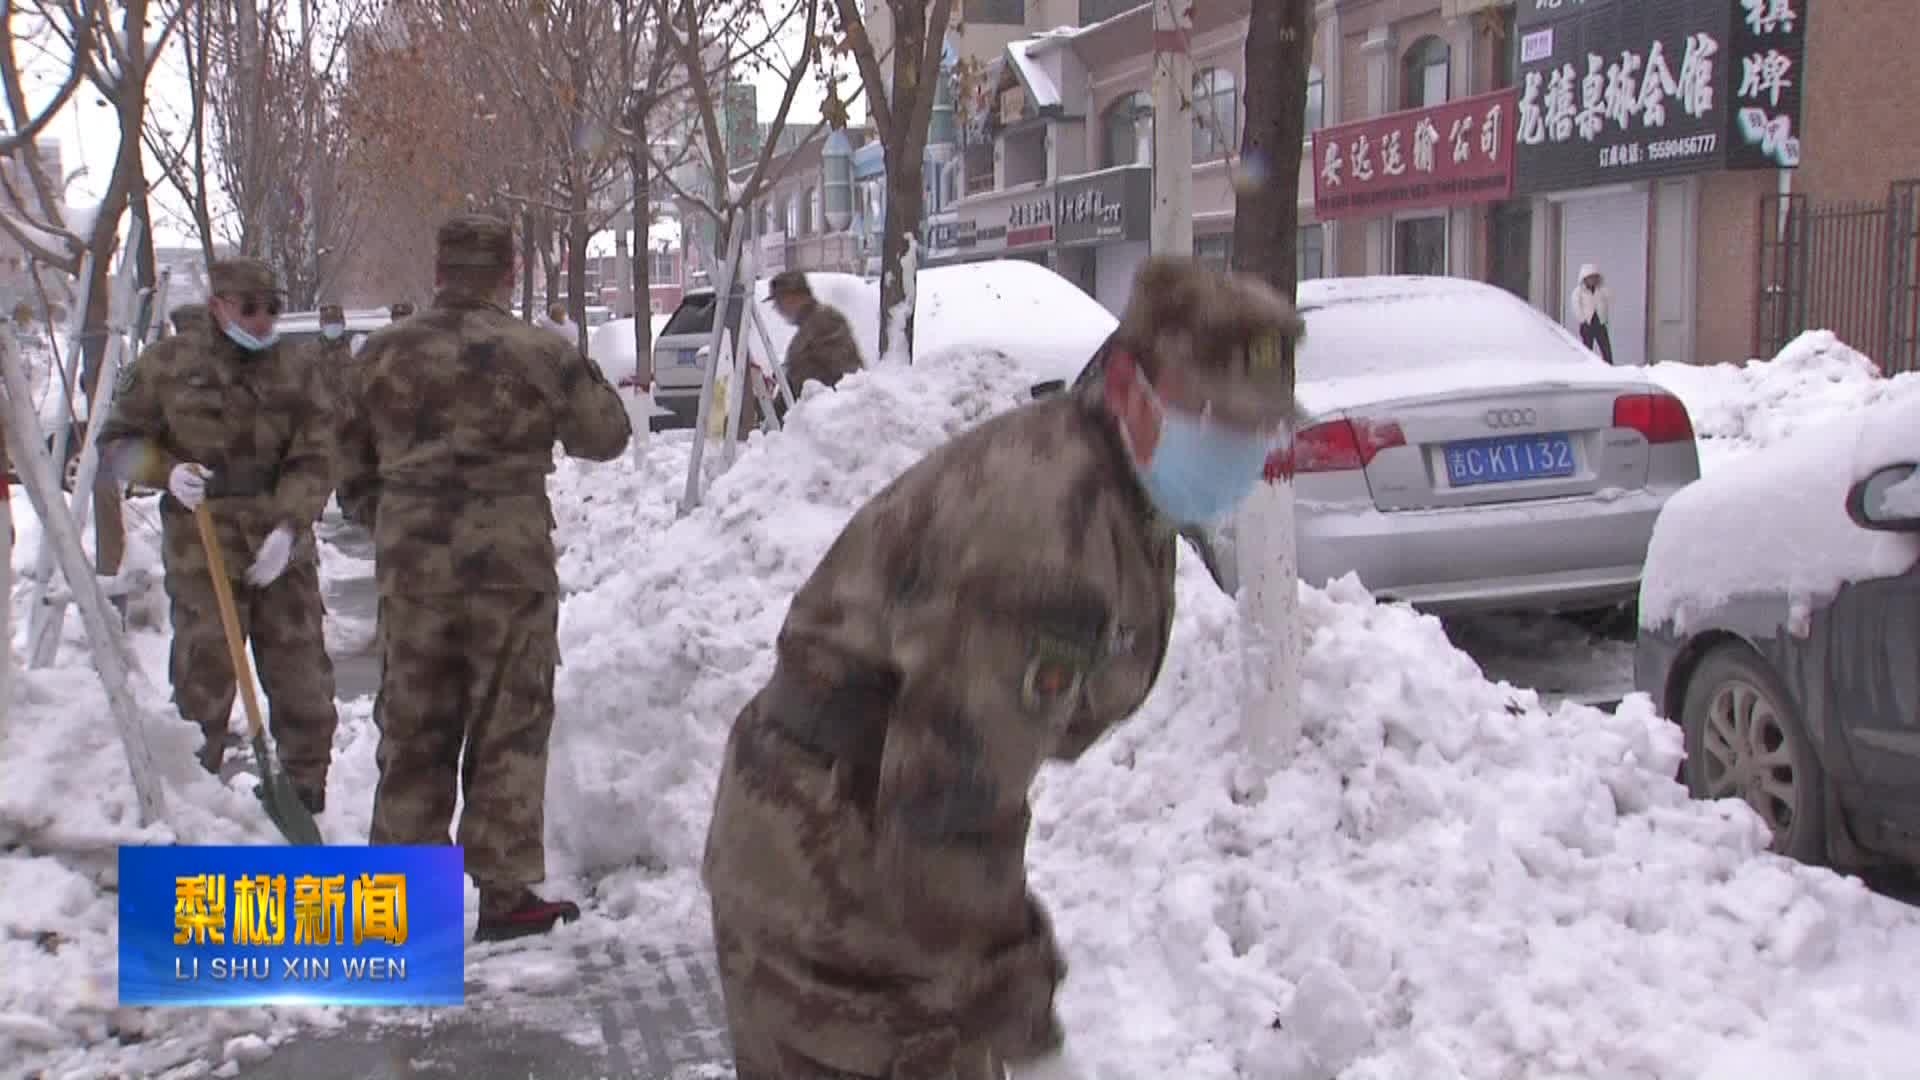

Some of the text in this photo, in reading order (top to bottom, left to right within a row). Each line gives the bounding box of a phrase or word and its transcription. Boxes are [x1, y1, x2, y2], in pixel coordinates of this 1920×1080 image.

[1320, 103, 1503, 186] 安达运输公司
